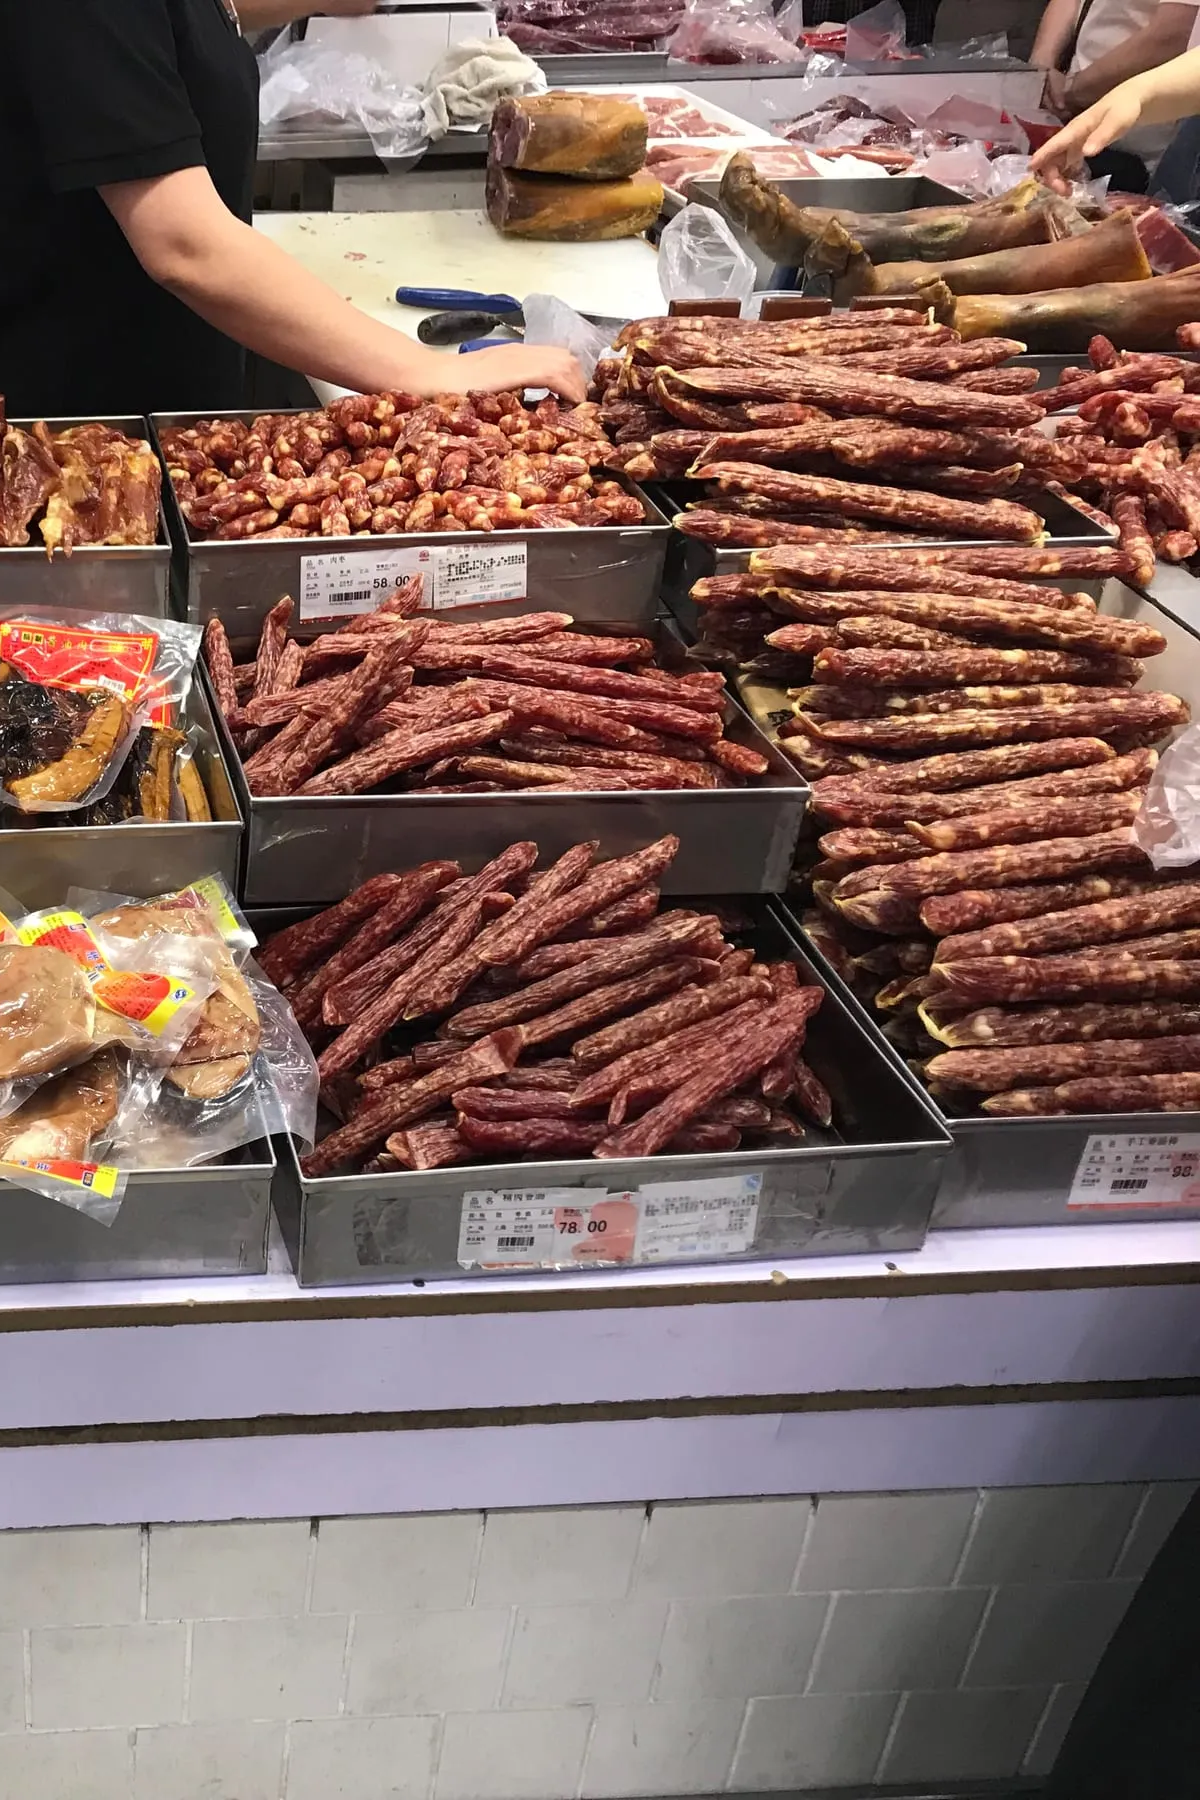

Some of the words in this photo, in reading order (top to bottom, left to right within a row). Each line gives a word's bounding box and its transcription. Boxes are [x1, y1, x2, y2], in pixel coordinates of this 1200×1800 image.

[330, 556, 346, 564] 肉枣
[373, 575, 410, 589] 58.00
[559, 1220, 607, 1234] 78.00
